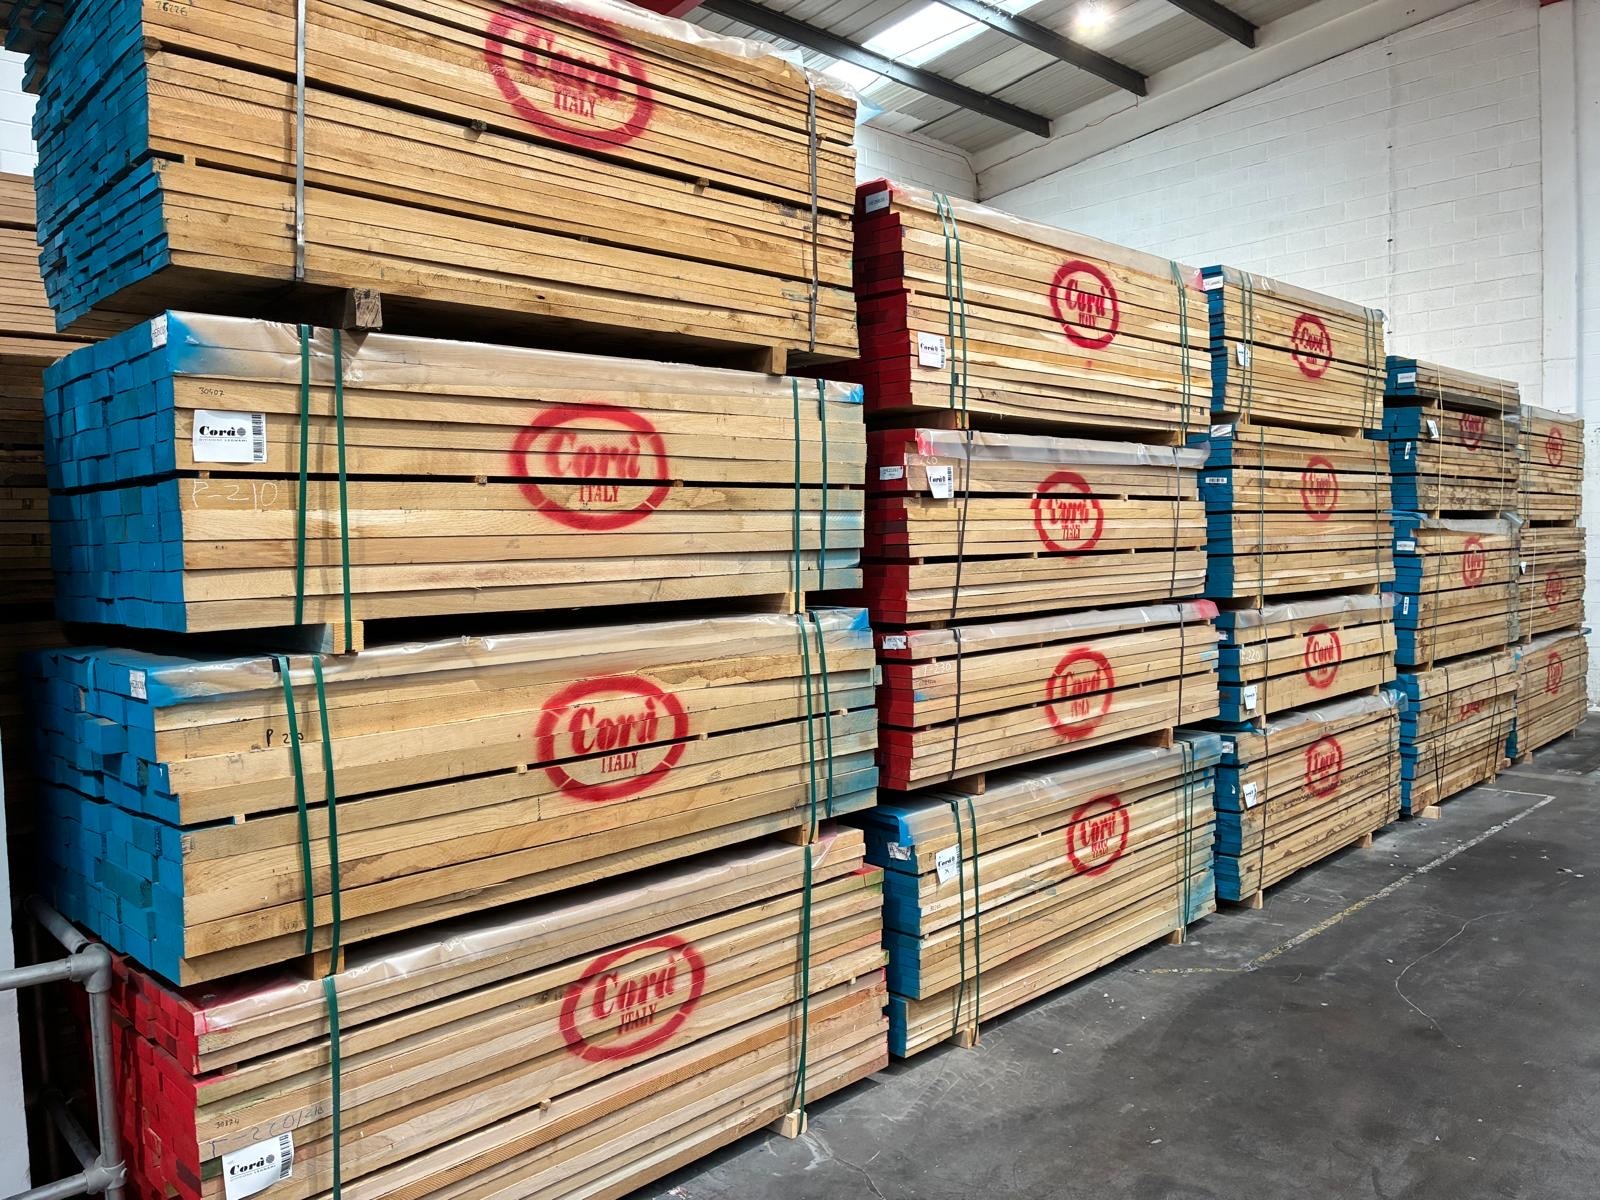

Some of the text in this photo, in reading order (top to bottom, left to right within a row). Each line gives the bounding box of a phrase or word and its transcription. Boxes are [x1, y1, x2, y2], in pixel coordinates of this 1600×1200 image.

[553, 89, 597, 119] ITALY
[577, 483, 622, 503] ITALY
[600, 752, 639, 774] ITALY
[617, 1002, 659, 1036] ITALY
